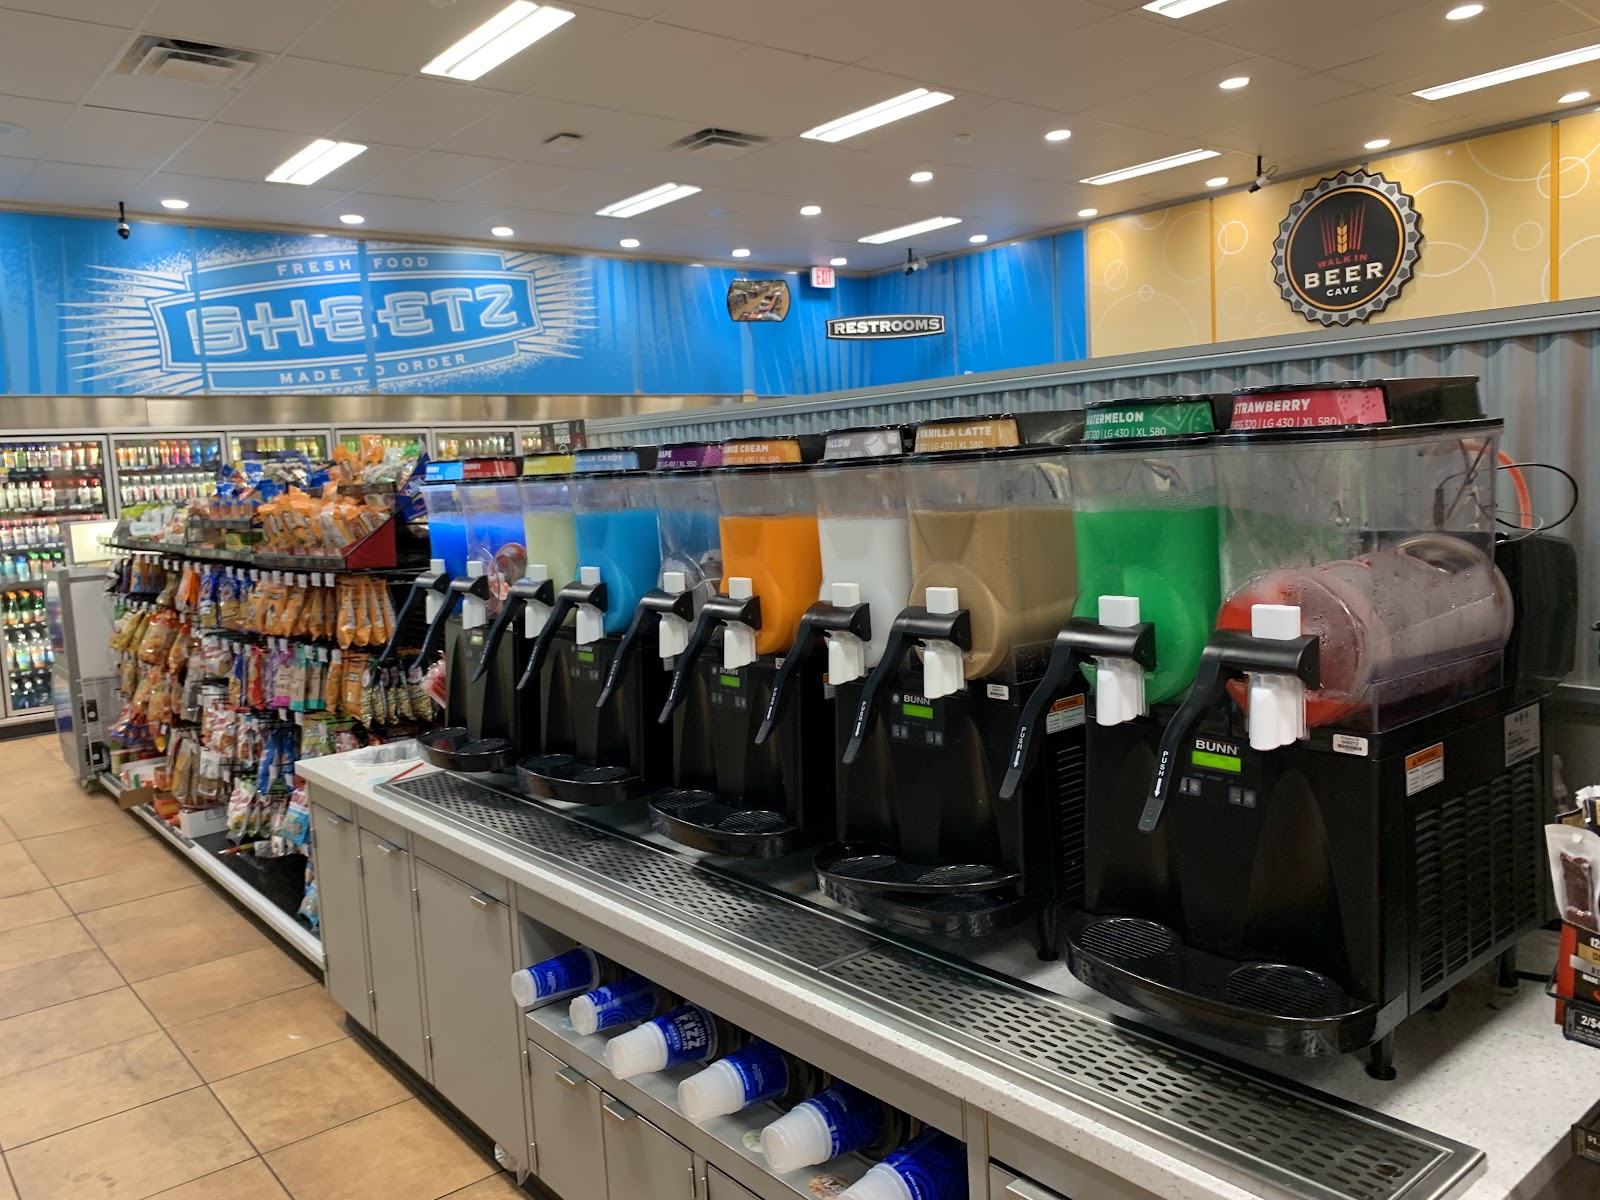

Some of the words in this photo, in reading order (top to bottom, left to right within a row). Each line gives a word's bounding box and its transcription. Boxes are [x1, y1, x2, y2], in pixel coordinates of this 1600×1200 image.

[277, 258, 352, 277] FRESH
[373, 256, 430, 271] FOOD
[1317, 256, 1351, 269] WALK
[1354, 254, 1368, 262] IN
[816, 268, 833, 285] EXIT
[1304, 262, 1385, 290] BEER
[1326, 285, 1358, 297] CAVE
[186, 284, 520, 357] SHEETZ
[834, 317, 941, 334] RESTROOMS
[279, 368, 341, 385] MADE
[353, 366, 386, 379] TO
[398, 354, 467, 374] ORDER
[1234, 399, 1311, 415] STRAWBERRY
[1263, 418, 1274, 428] LG
[1276, 418, 1294, 428] 430
[1303, 417, 1315, 427] XL
[1318, 417, 1336, 426] 580
[920, 428, 955, 438] VANILLA
[958, 426, 992, 436] LATTE
[1104, 429, 1113, 438] LG
[1114, 428, 1129, 437] 430
[1136, 428, 1147, 437] XL
[1150, 427, 1166, 436] 580
[740, 445, 769, 453] CREAM
[959, 441, 967, 449] XL
[597, 454, 624, 462] CANDY
[903, 694, 930, 706] BUNN
[858, 700, 867, 721] PUSH
[1017, 727, 1027, 750] PUSH
[1195, 739, 1238, 755] BUNN
[1158, 750, 1169, 777] PUSH
[678, 1013, 701, 1050] FIZZ
